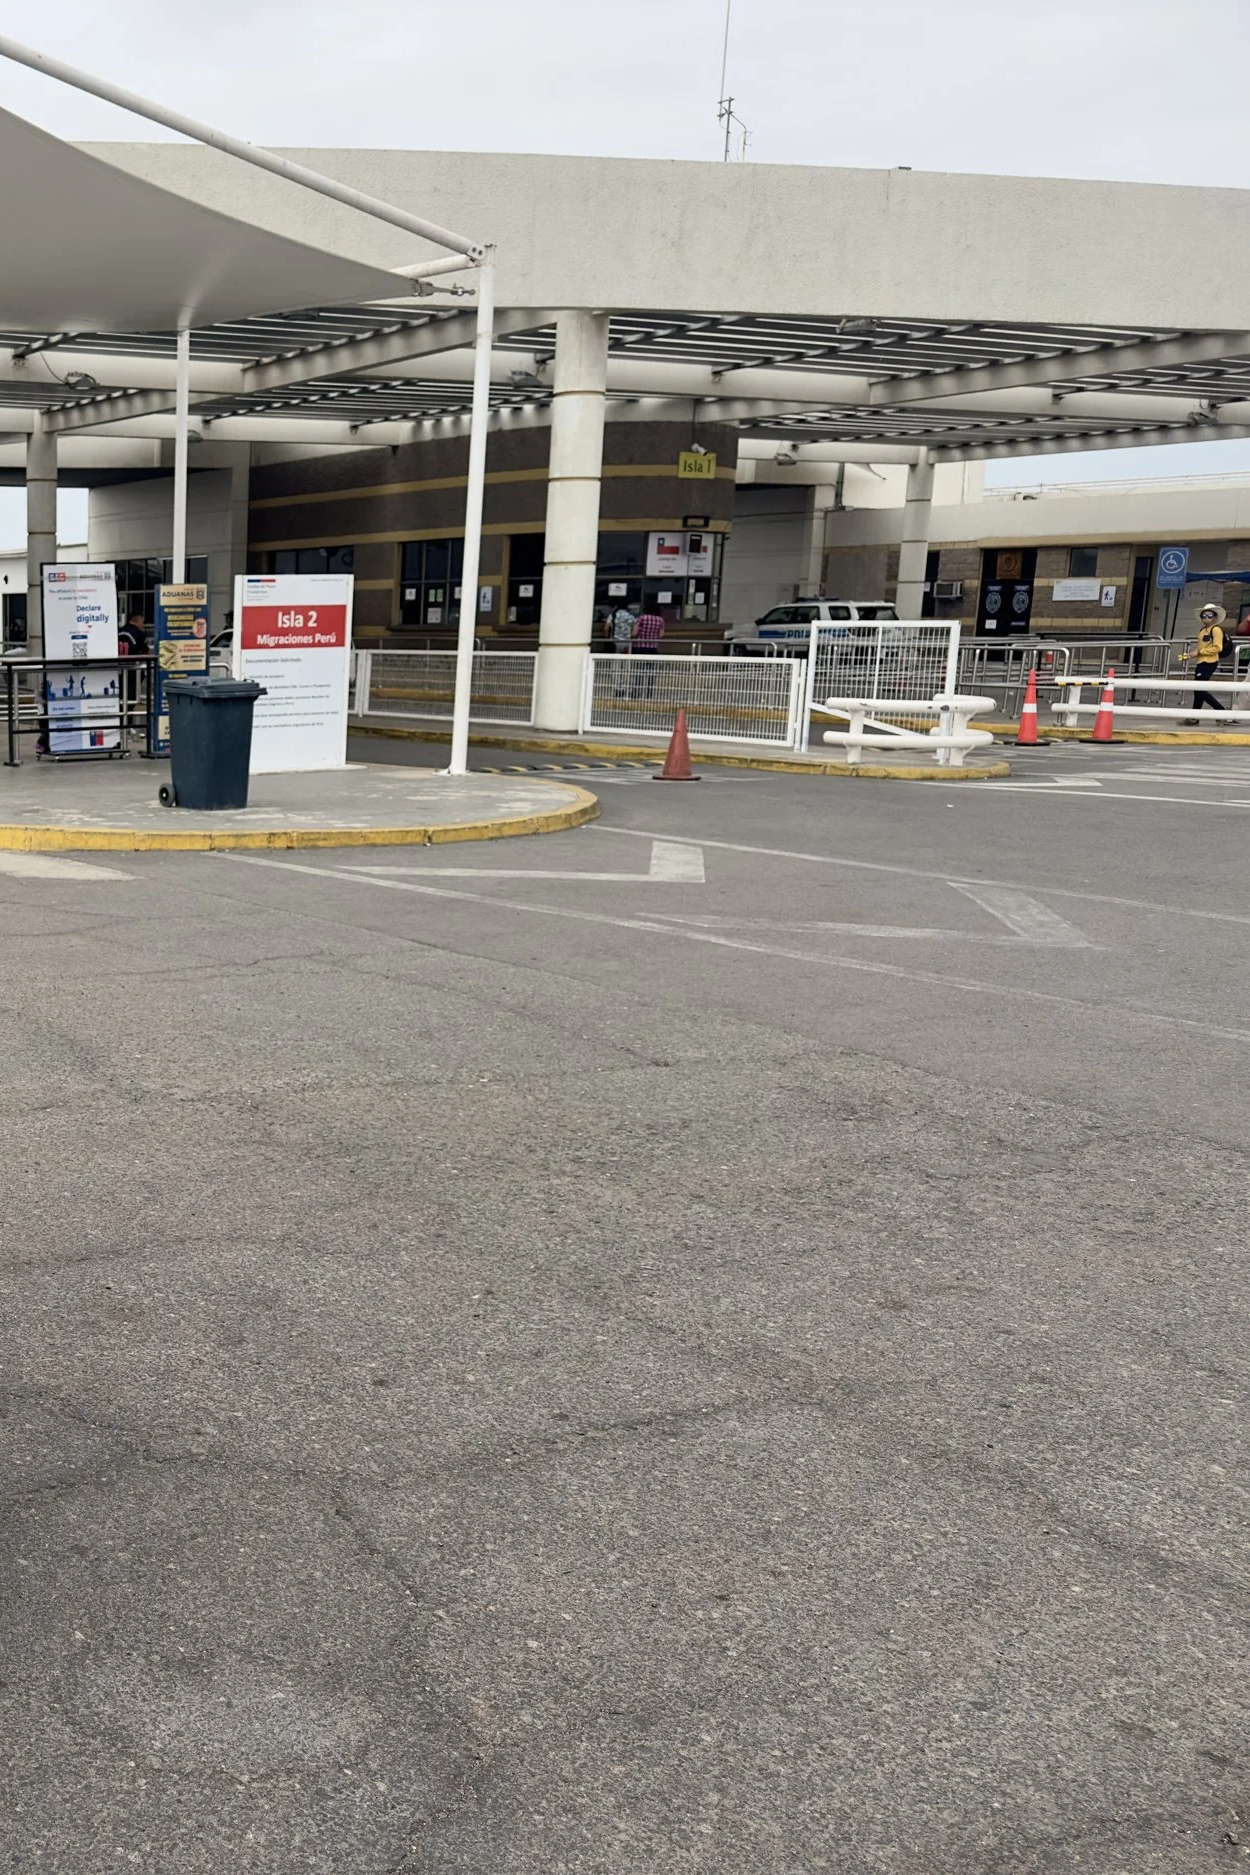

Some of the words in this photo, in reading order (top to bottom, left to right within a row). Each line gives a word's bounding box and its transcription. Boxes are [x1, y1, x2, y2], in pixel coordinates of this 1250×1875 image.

[683, 460, 703, 473] Isla
[76, 614, 110, 624] digitally
[277, 611, 304, 628] Isla
[308, 610, 318, 627] 2
[256, 633, 313, 647] Migraciones
[314, 631, 337, 643] Perú
